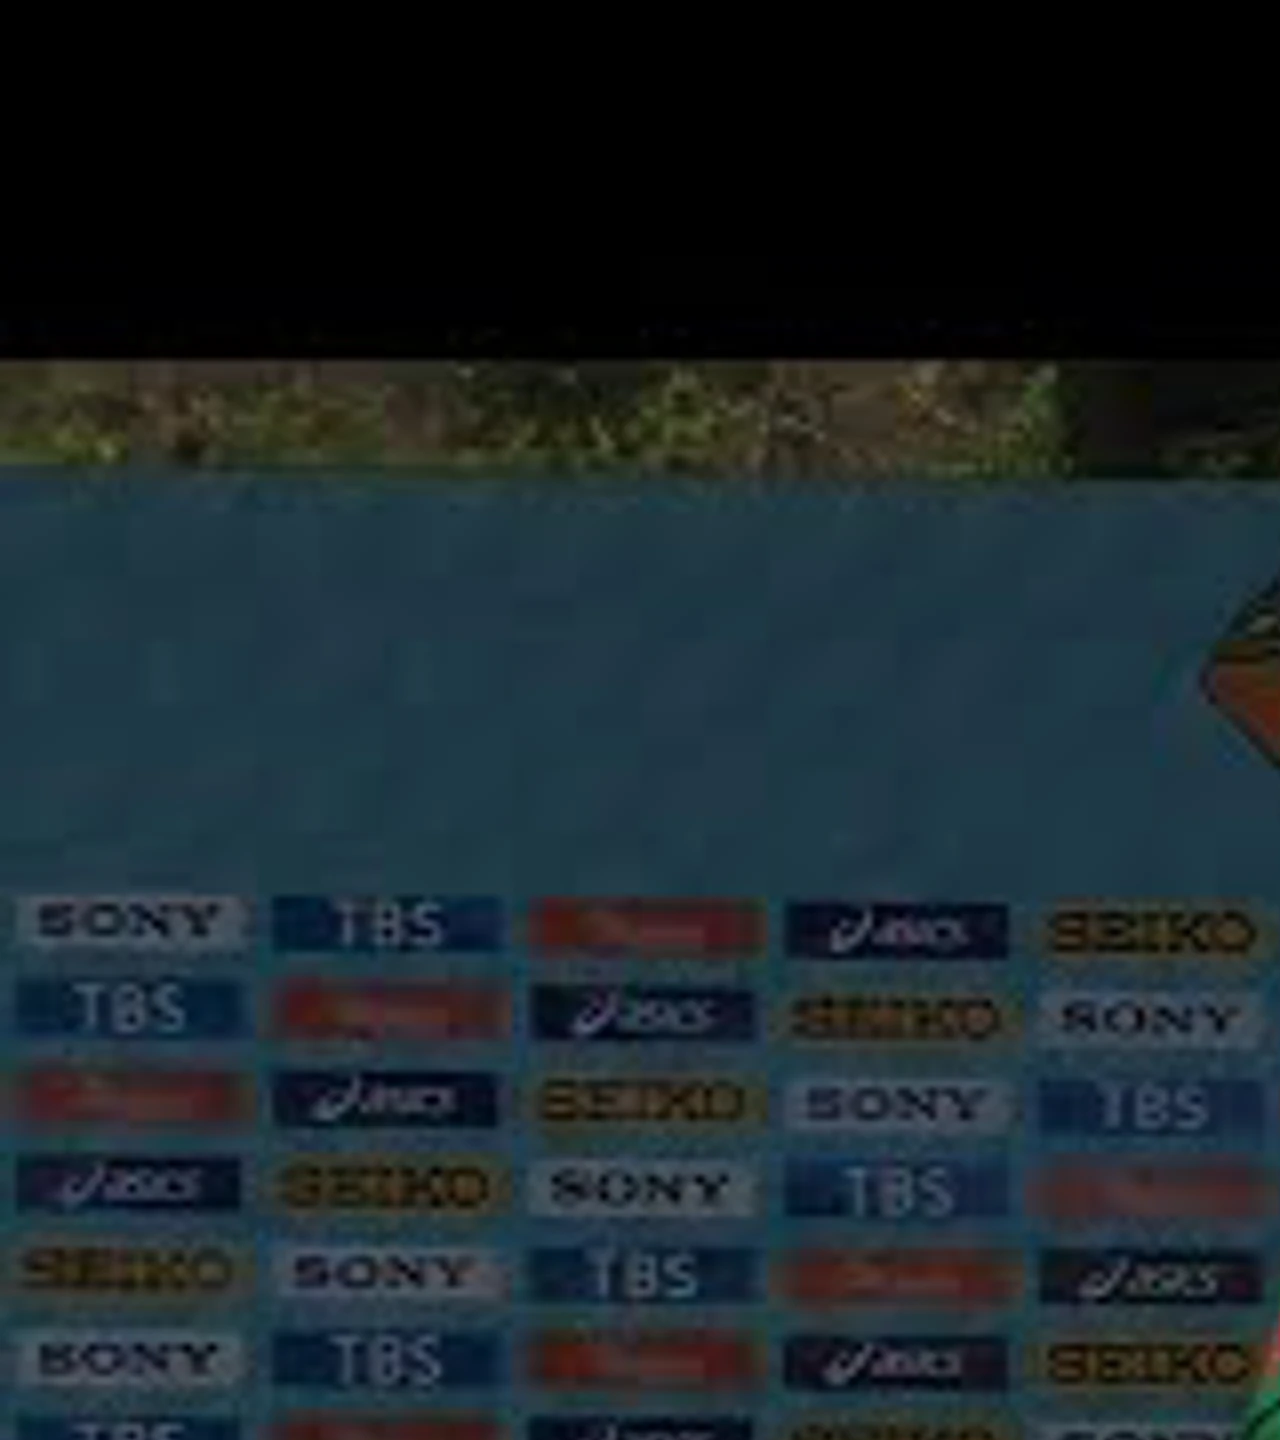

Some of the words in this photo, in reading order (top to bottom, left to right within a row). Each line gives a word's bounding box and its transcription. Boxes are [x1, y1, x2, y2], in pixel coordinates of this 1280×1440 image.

[38, 902, 217, 936] SONY
[330, 900, 447, 950] TBS
[1048, 911, 1255, 954] SEIKO
[73, 983, 190, 1033] TBS
[794, 996, 1001, 1039] SEIKO
[1059, 1002, 1238, 1036] SONY
[805, 1087, 984, 1121] SONY
[1095, 1082, 1212, 1132] TBS
[282, 1165, 489, 1208] SEIKO
[551, 1170, 730, 1204] SONY
[839, 1167, 956, 1217] TBS
[293, 1255, 472, 1289] SONY
[584, 1250, 701, 1300] TBS
[37, 1340, 216, 1374] SONY
[328, 1334, 445, 1384] TBS
